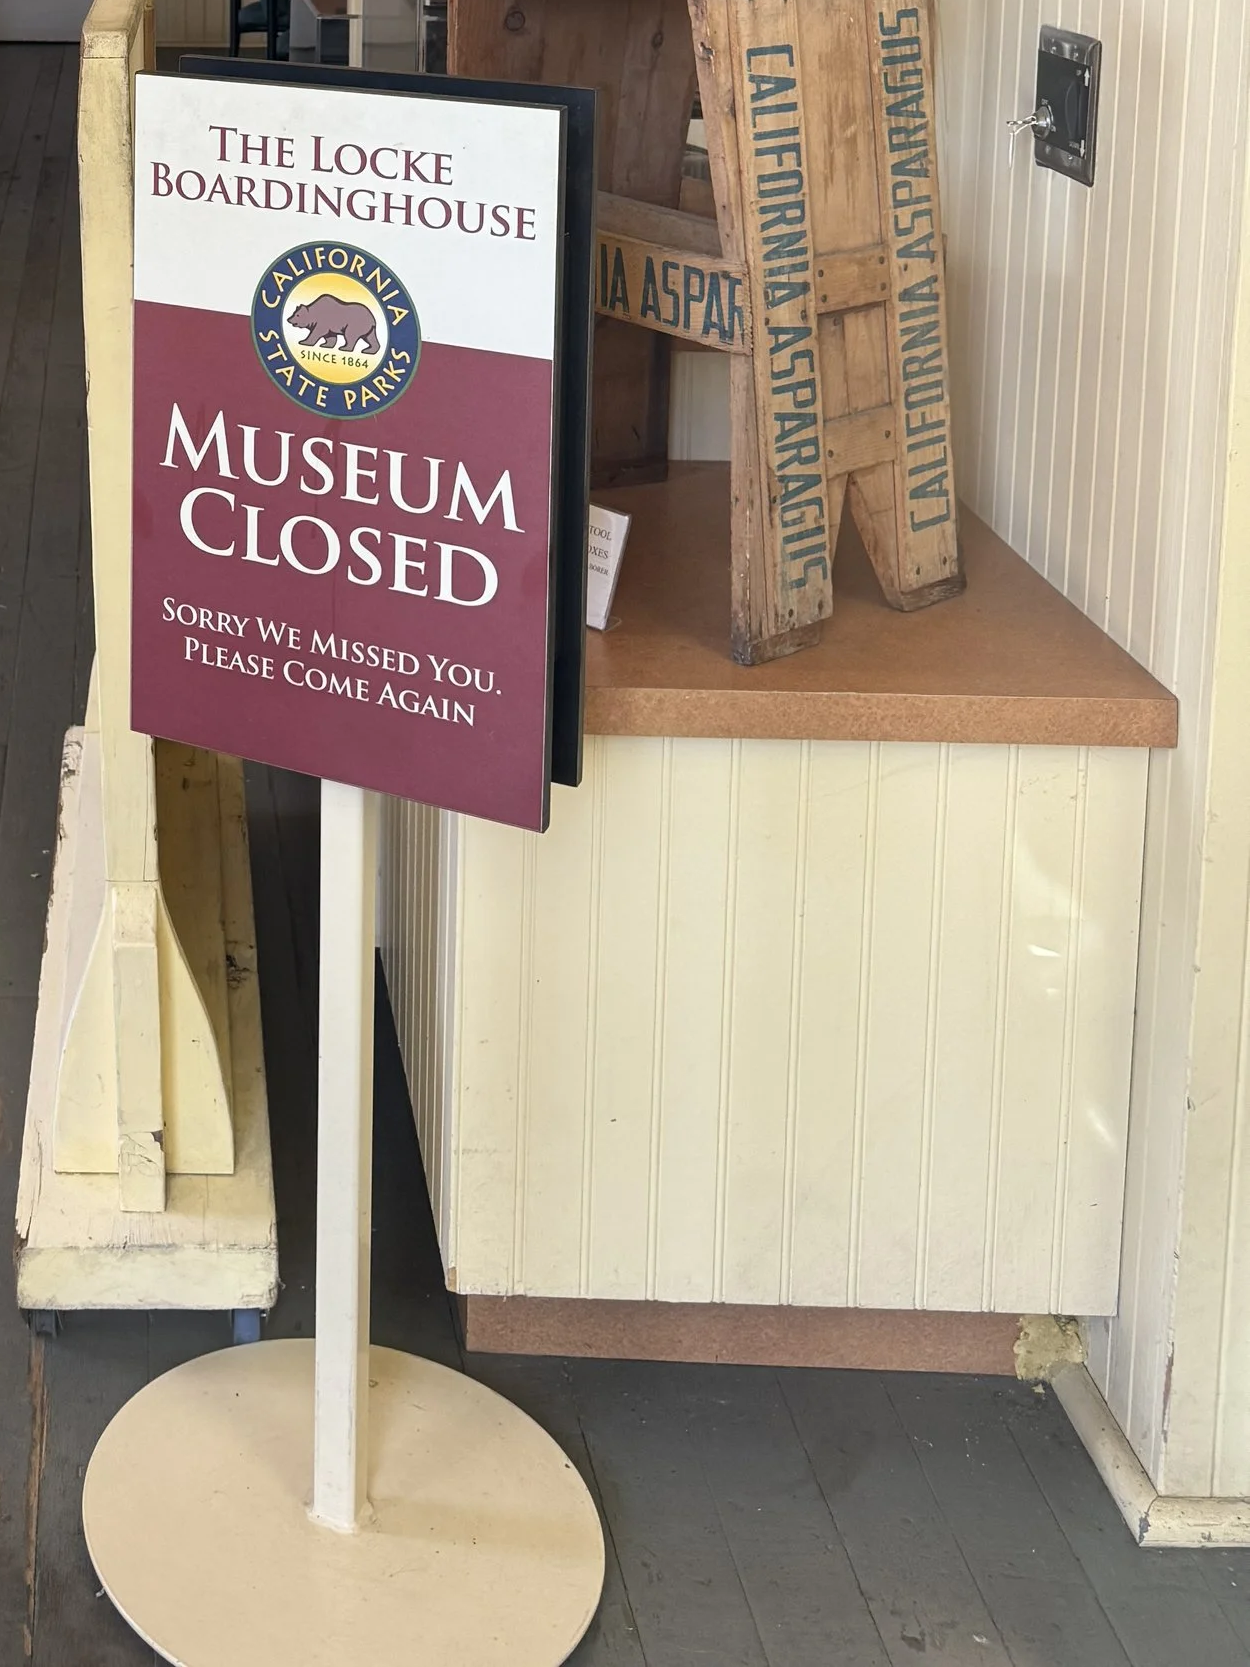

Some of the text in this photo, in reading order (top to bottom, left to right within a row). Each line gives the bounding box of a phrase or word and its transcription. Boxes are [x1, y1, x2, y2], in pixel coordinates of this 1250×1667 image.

[151, 161, 537, 241] BOARDINGHOUSE
[208, 124, 454, 186] THE LOCKE
[261, 246, 410, 327] CALIFORNIA
[746, 43, 829, 590] CALIFORNIA ASPARAGUS
[878, 8, 951, 537] CALIFORNIA ASPARAGUS
[258, 328, 411, 411] STATE PARKS
[300, 349, 370, 370] SINCE 1864
[158, 401, 526, 534] MUSEUM
[178, 486, 500, 608] CLOSED
[162, 596, 503, 696] SORRY WE MISSED YOU.
[183, 635, 476, 727] PLEASE COME AGAIN
